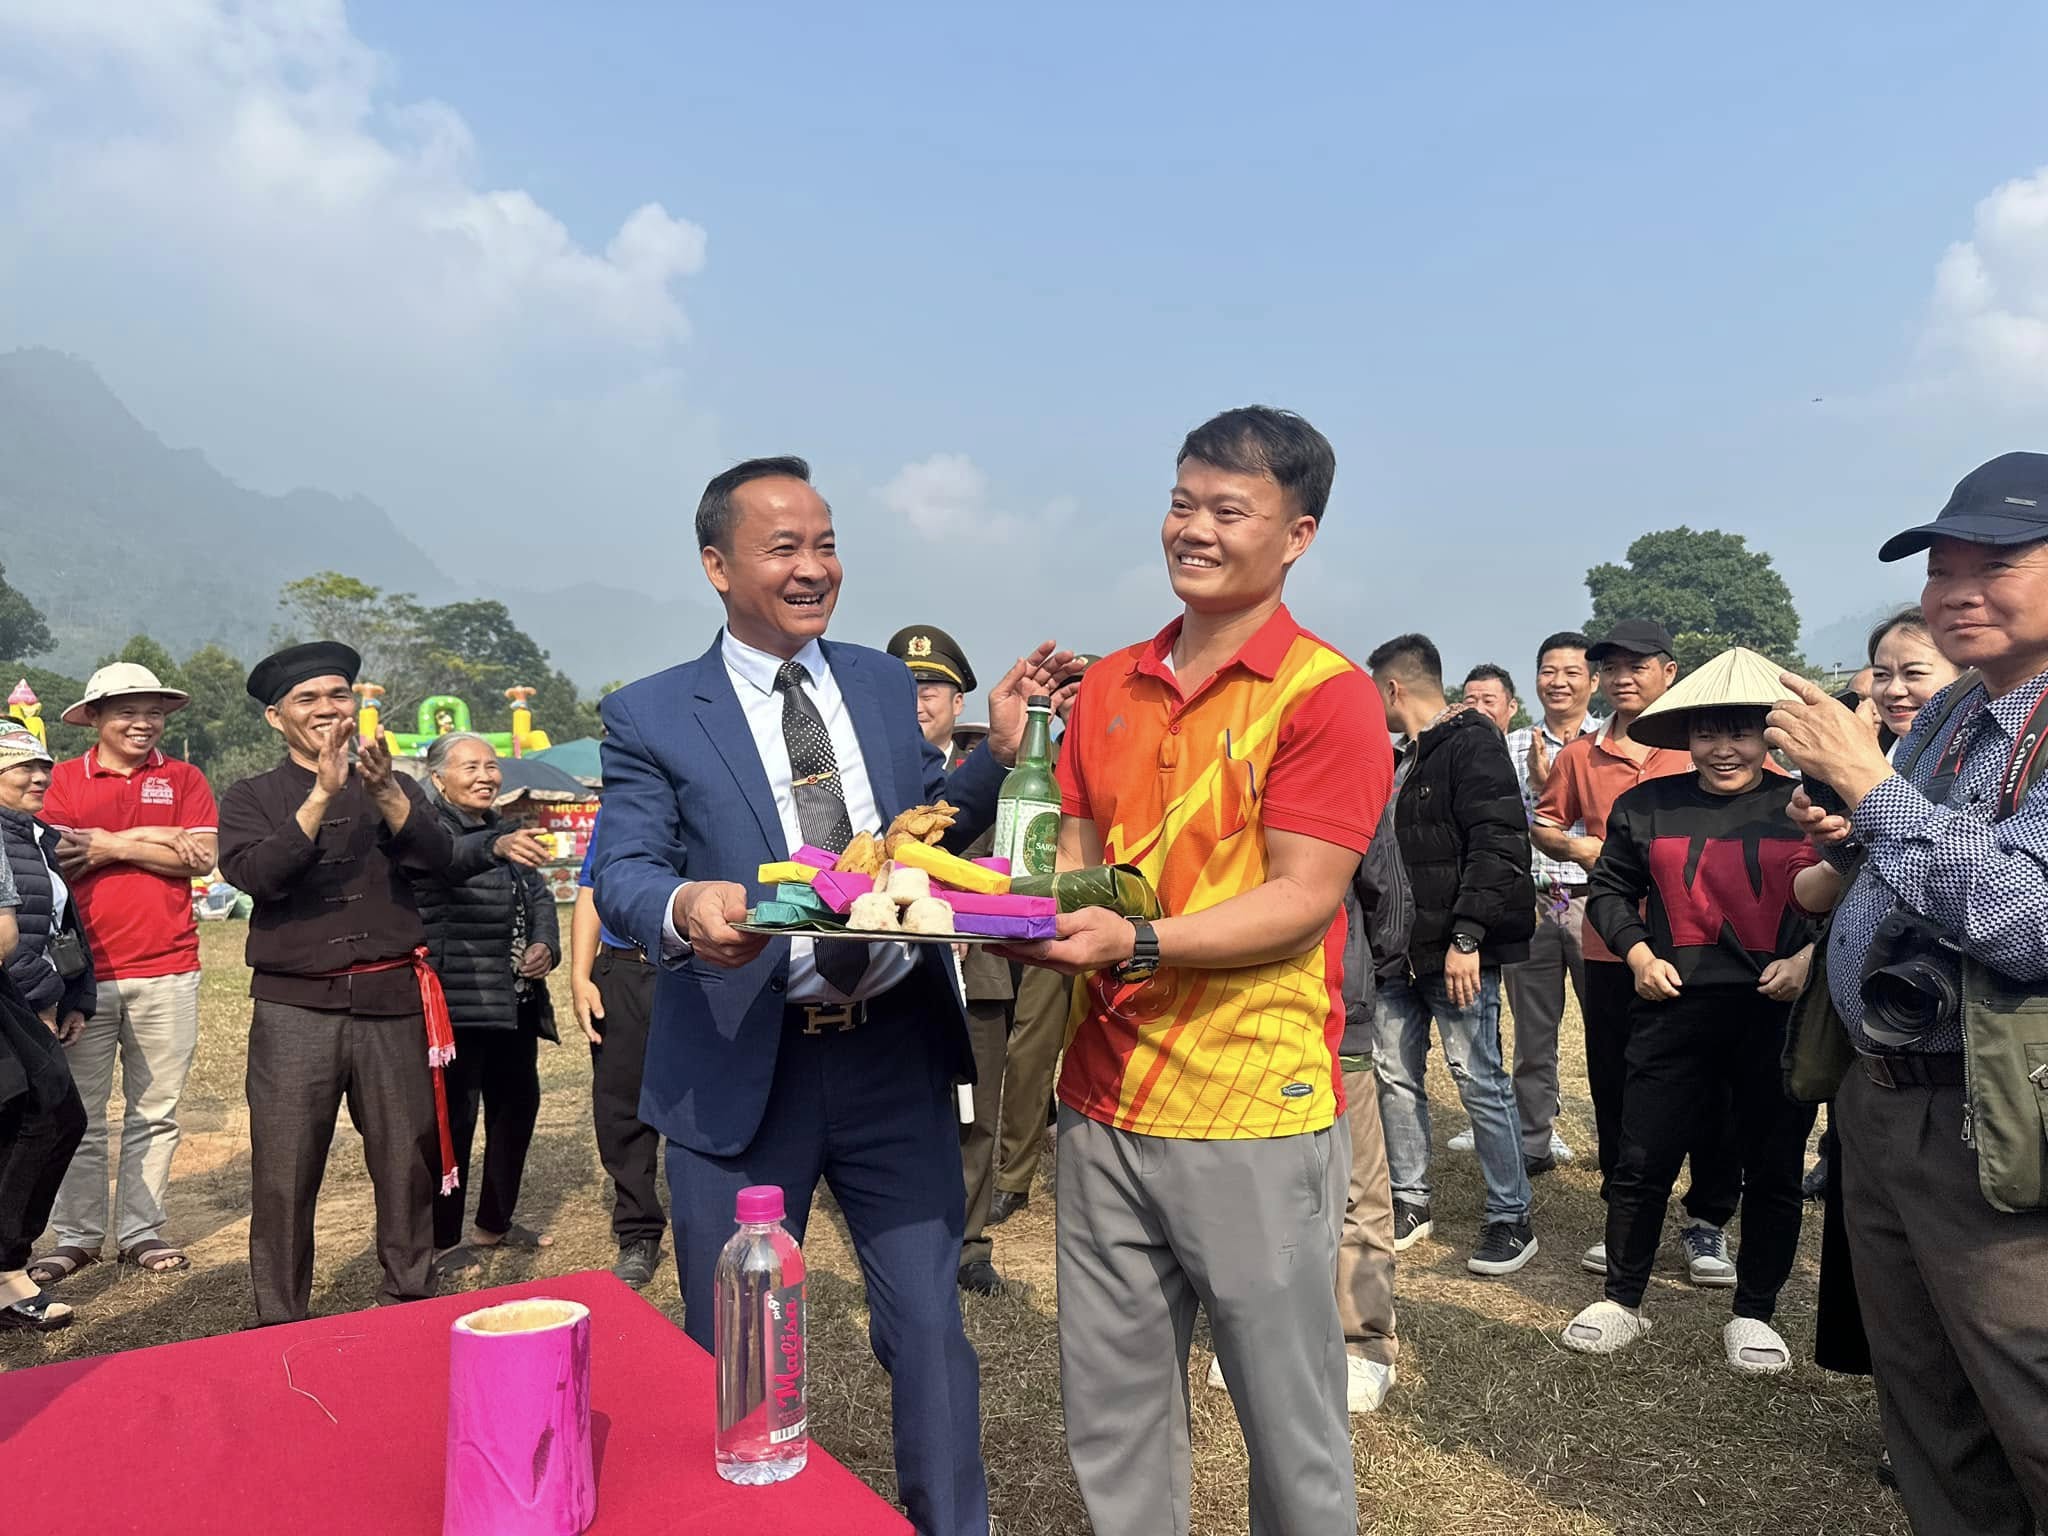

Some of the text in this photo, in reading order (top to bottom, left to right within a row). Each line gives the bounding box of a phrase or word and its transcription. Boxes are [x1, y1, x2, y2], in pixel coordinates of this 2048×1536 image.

[2005, 733, 2036, 794] Canon
[1035, 842, 1057, 851] SAIGO
[774, 1297, 803, 1408] Malisa
